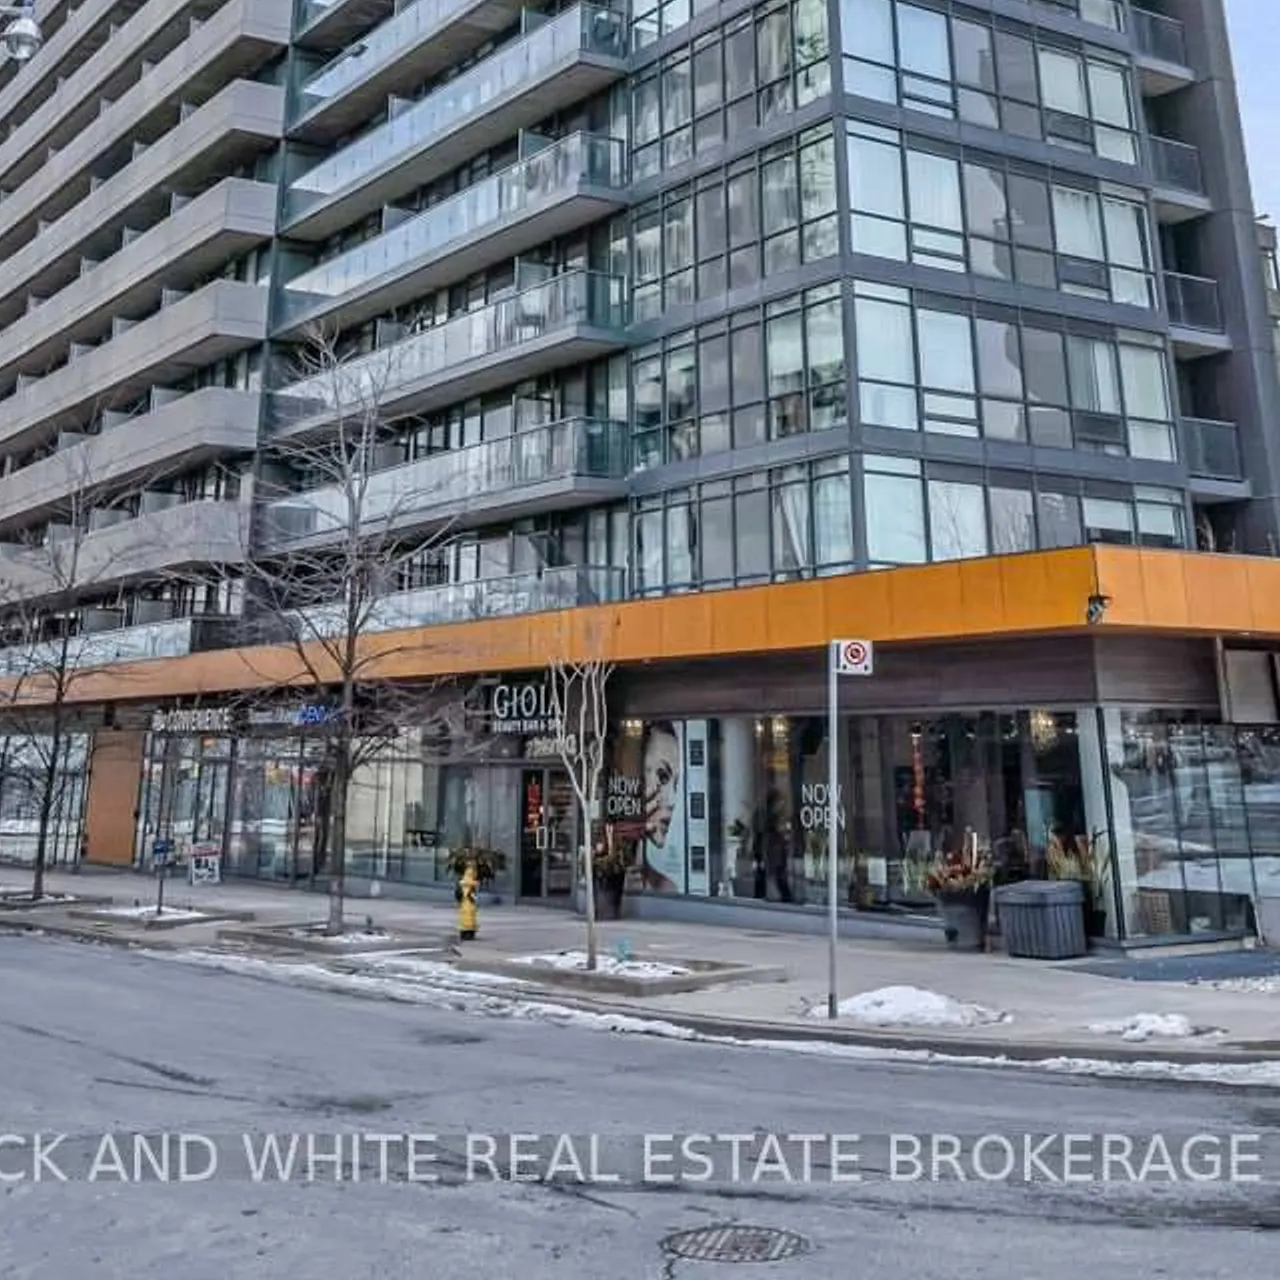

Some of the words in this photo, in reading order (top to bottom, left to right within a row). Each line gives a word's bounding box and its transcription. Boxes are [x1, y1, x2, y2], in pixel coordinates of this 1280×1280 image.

[494, 684, 563, 718] GIOIA
[609, 776, 640, 795] NOW
[608, 796, 641, 816] OPEN
[801, 806, 846, 830] OPEN
